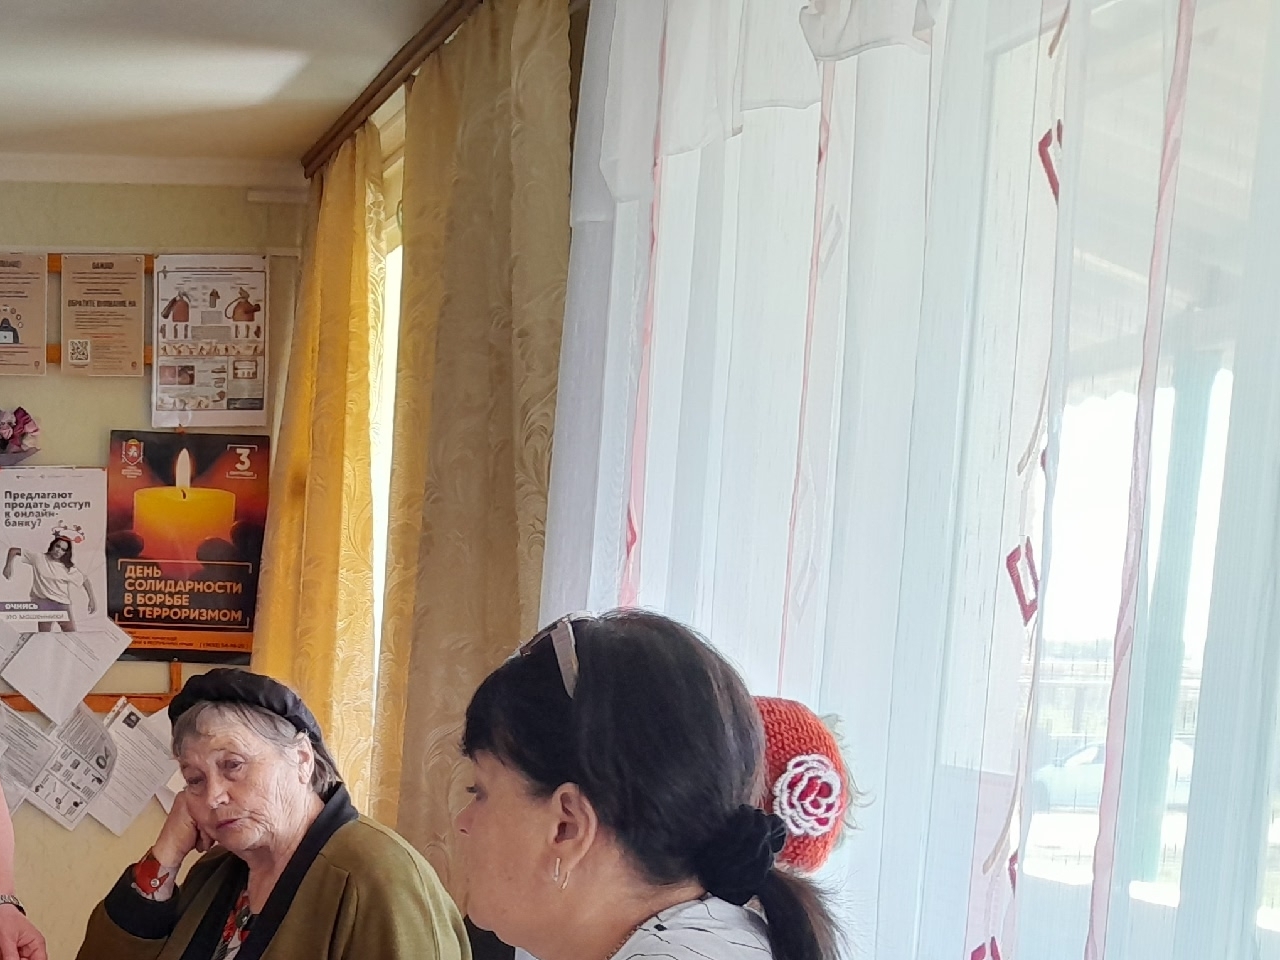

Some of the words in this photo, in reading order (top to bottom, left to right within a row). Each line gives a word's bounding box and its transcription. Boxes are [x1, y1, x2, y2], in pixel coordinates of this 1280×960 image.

[234, 447, 251, 471] 3
[4, 490, 73, 502] Предлагают
[4, 501, 51, 511] продать
[53, 501, 91, 511] доступ
[13, 508, 59, 518] онлайн-
[4, 518, 42, 530] банку?
[124, 565, 162, 579] ДЕНЬ
[124, 579, 243, 594] СОЛИДАРНОСТИ
[124, 593, 133, 604] В
[136, 593, 190, 606] БОРЬБЕ
[123, 606, 134, 618] С
[137, 607, 243, 622] ТЕРРОРИЗМОМ
